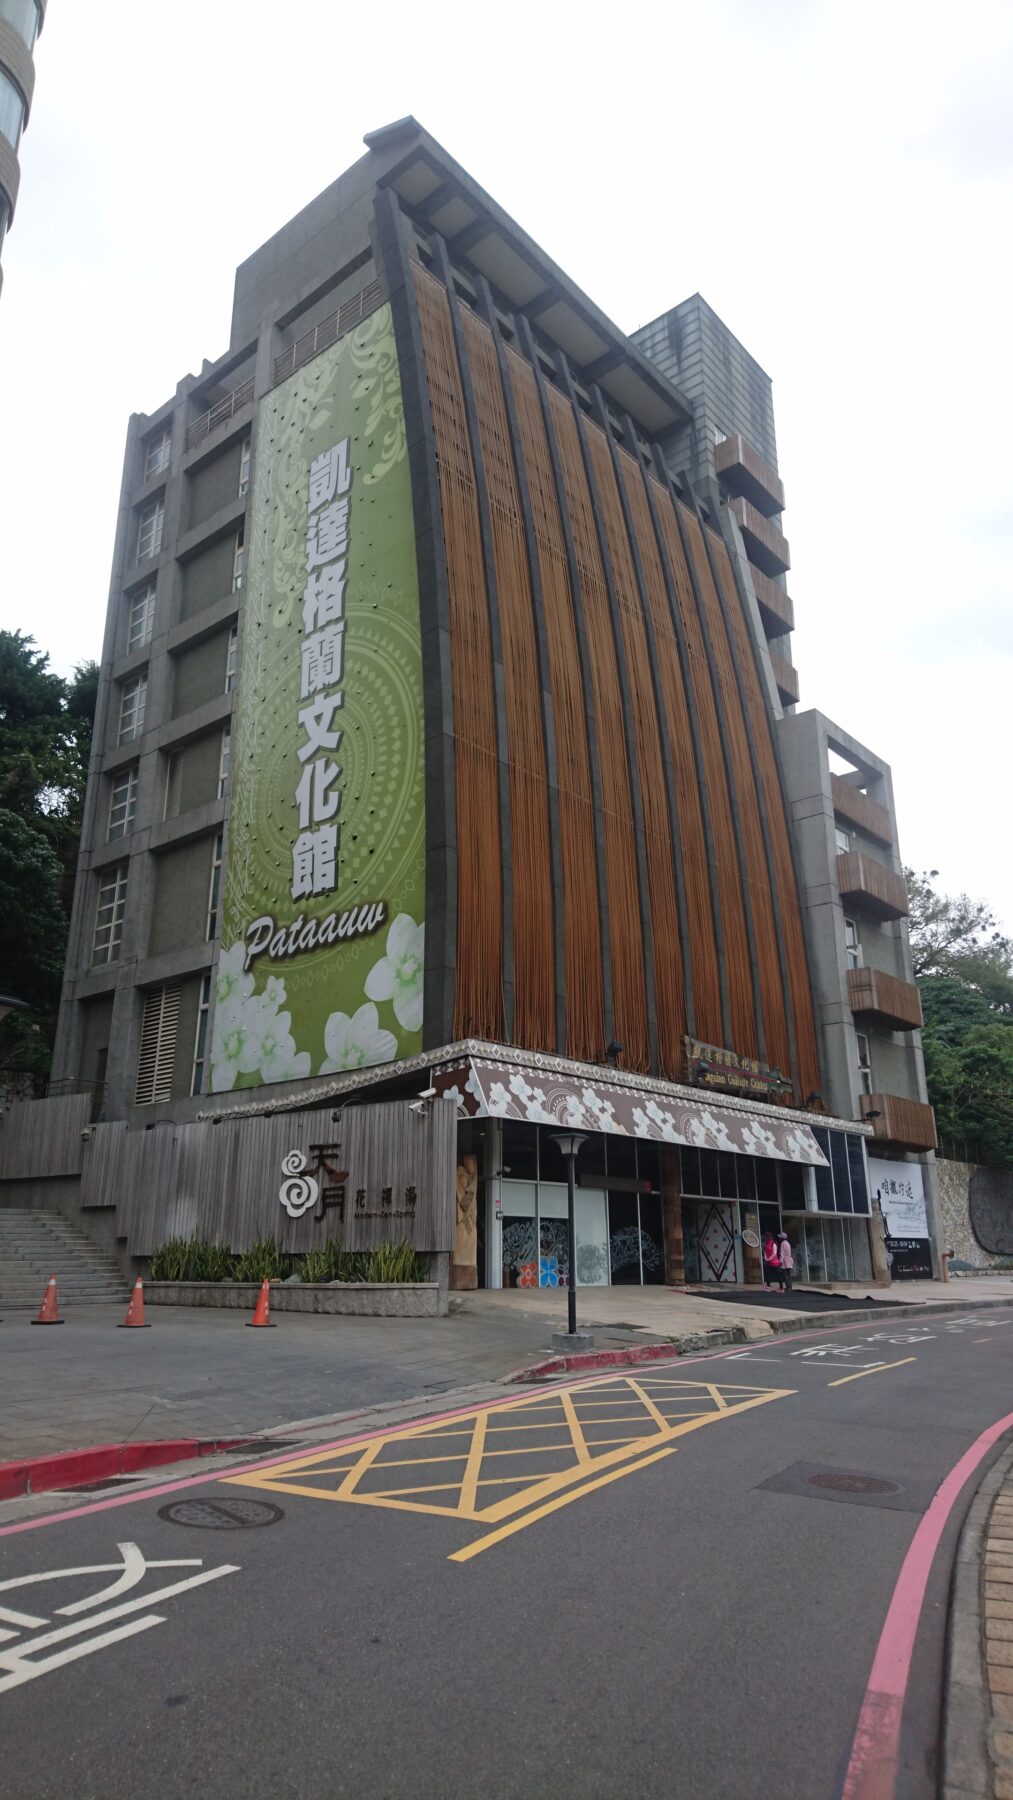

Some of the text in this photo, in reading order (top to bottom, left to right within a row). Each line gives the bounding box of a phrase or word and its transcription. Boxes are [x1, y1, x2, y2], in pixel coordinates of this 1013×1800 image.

[290, 437, 352, 900] 凱達格蘭文化館
[300, 1143, 350, 1223] 天月
